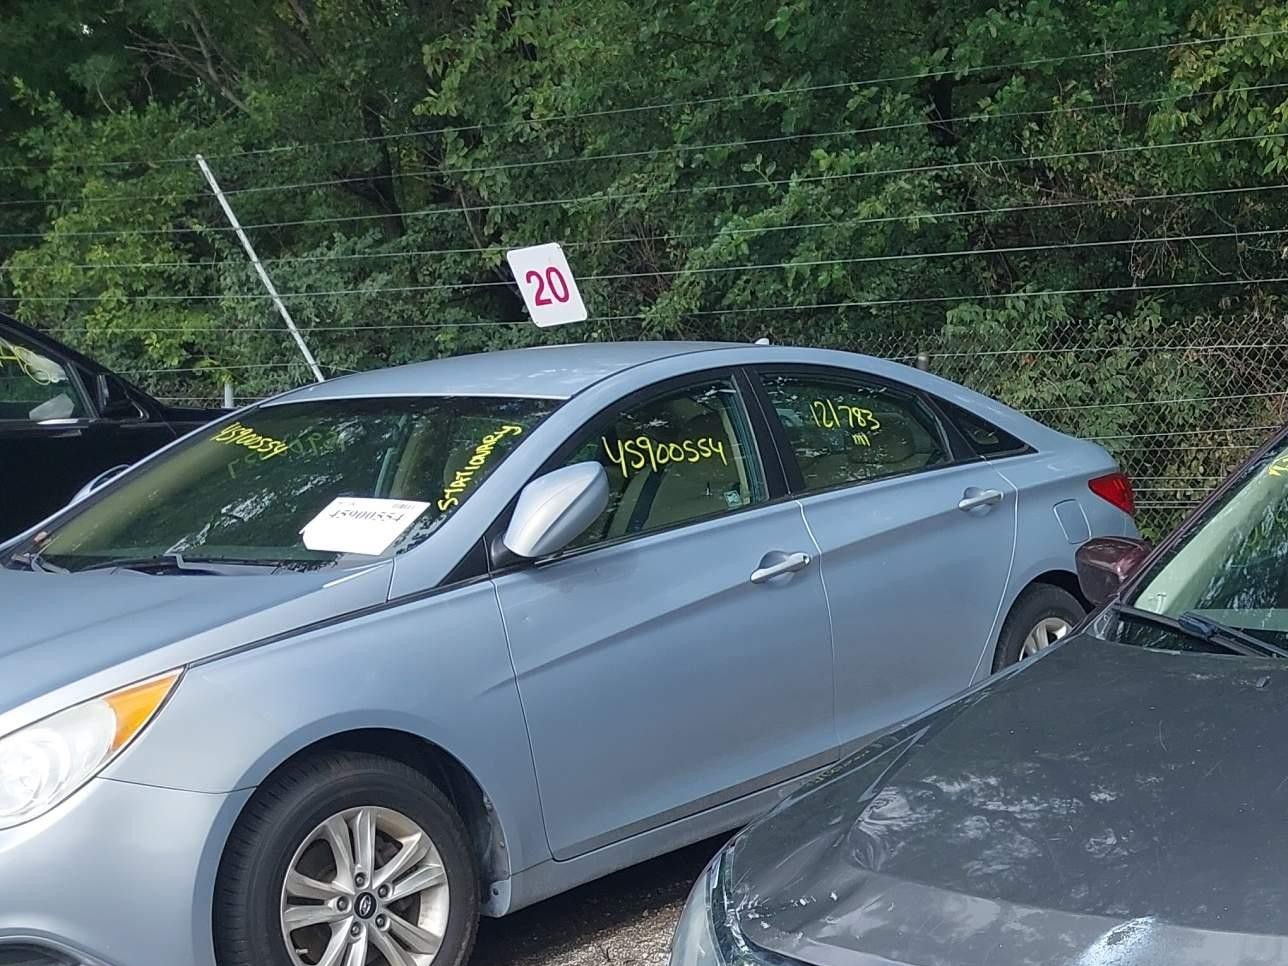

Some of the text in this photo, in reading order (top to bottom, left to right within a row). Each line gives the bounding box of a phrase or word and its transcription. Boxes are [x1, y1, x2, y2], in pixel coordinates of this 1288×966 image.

[525, 267, 570, 306] 20
[808, 399, 881, 430] 121783
[601, 436, 728, 478] 45900554
